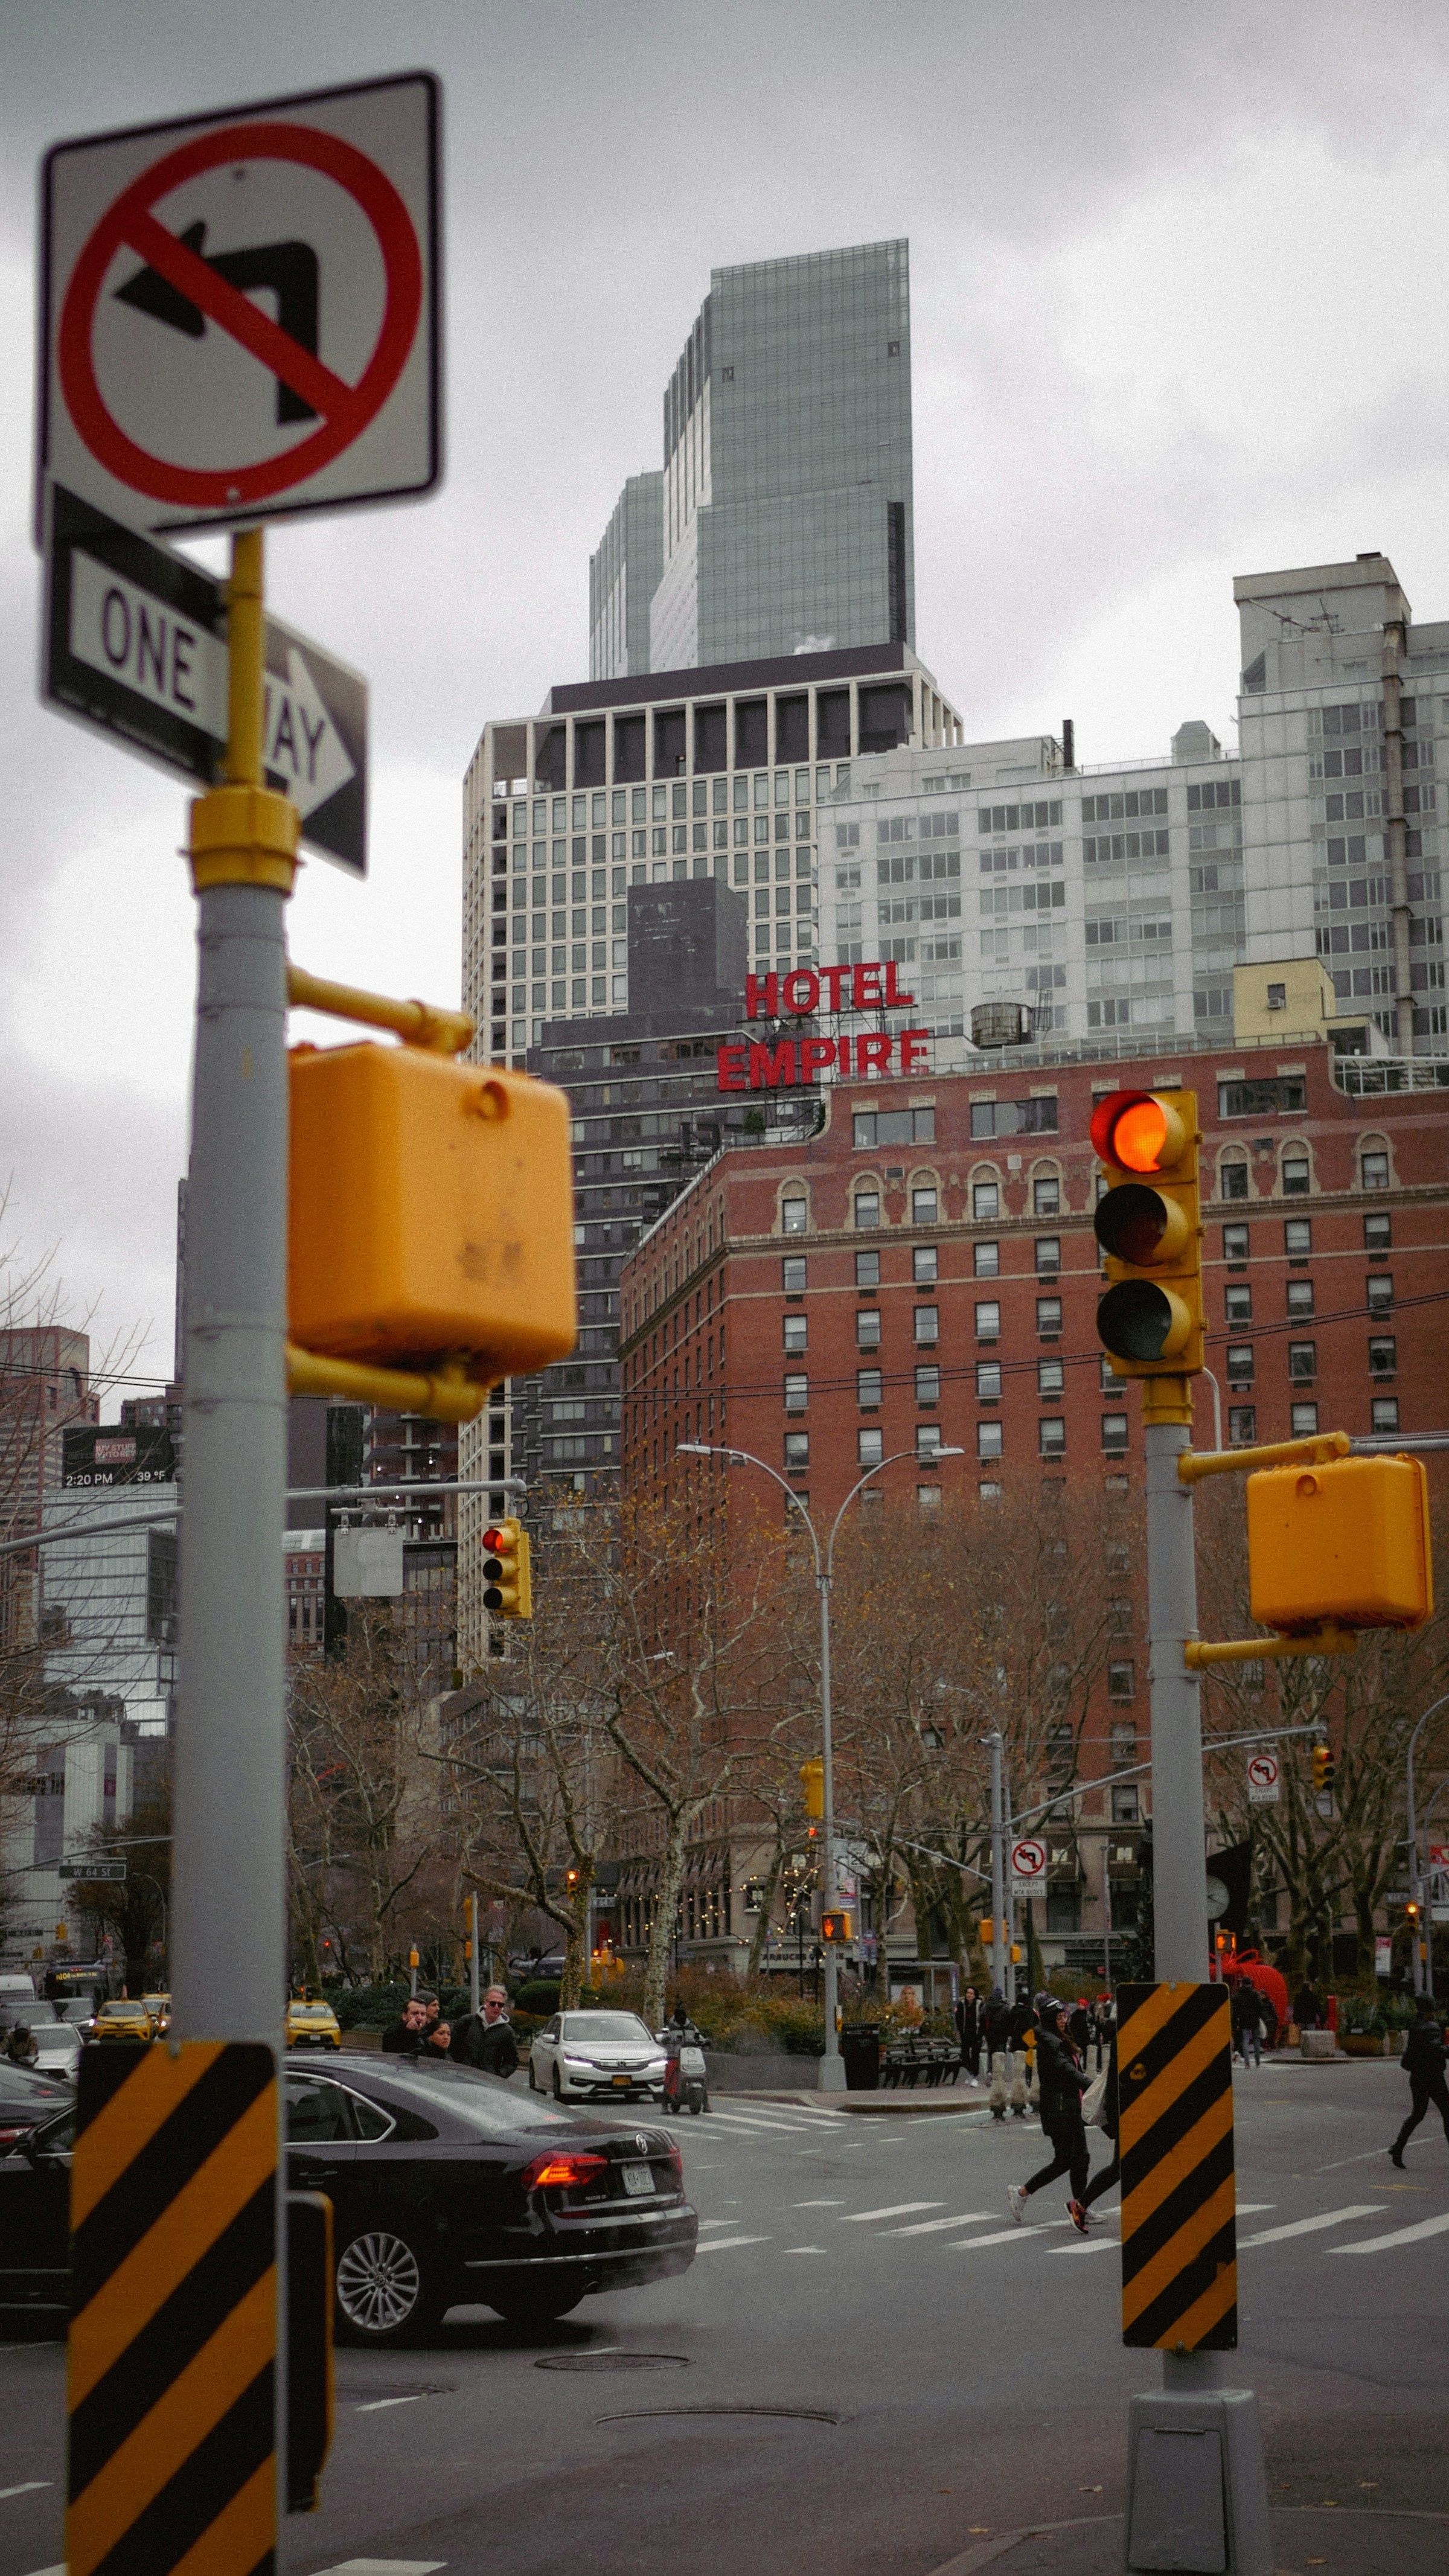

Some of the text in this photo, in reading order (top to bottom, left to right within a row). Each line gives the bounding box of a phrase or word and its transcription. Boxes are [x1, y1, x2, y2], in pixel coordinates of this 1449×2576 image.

[103, 587, 196, 712] ONE
[264, 685, 325, 784] AY
[746, 960, 913, 1019] HOTEL
[717, 1029, 930, 1091] EMPIRE
[66, 1473, 113, 1486] 2:20 PM
[137, 1471, 151, 1481] 39
[73, 1868, 82, 1876] W
[86, 1867, 97, 1877] 64
